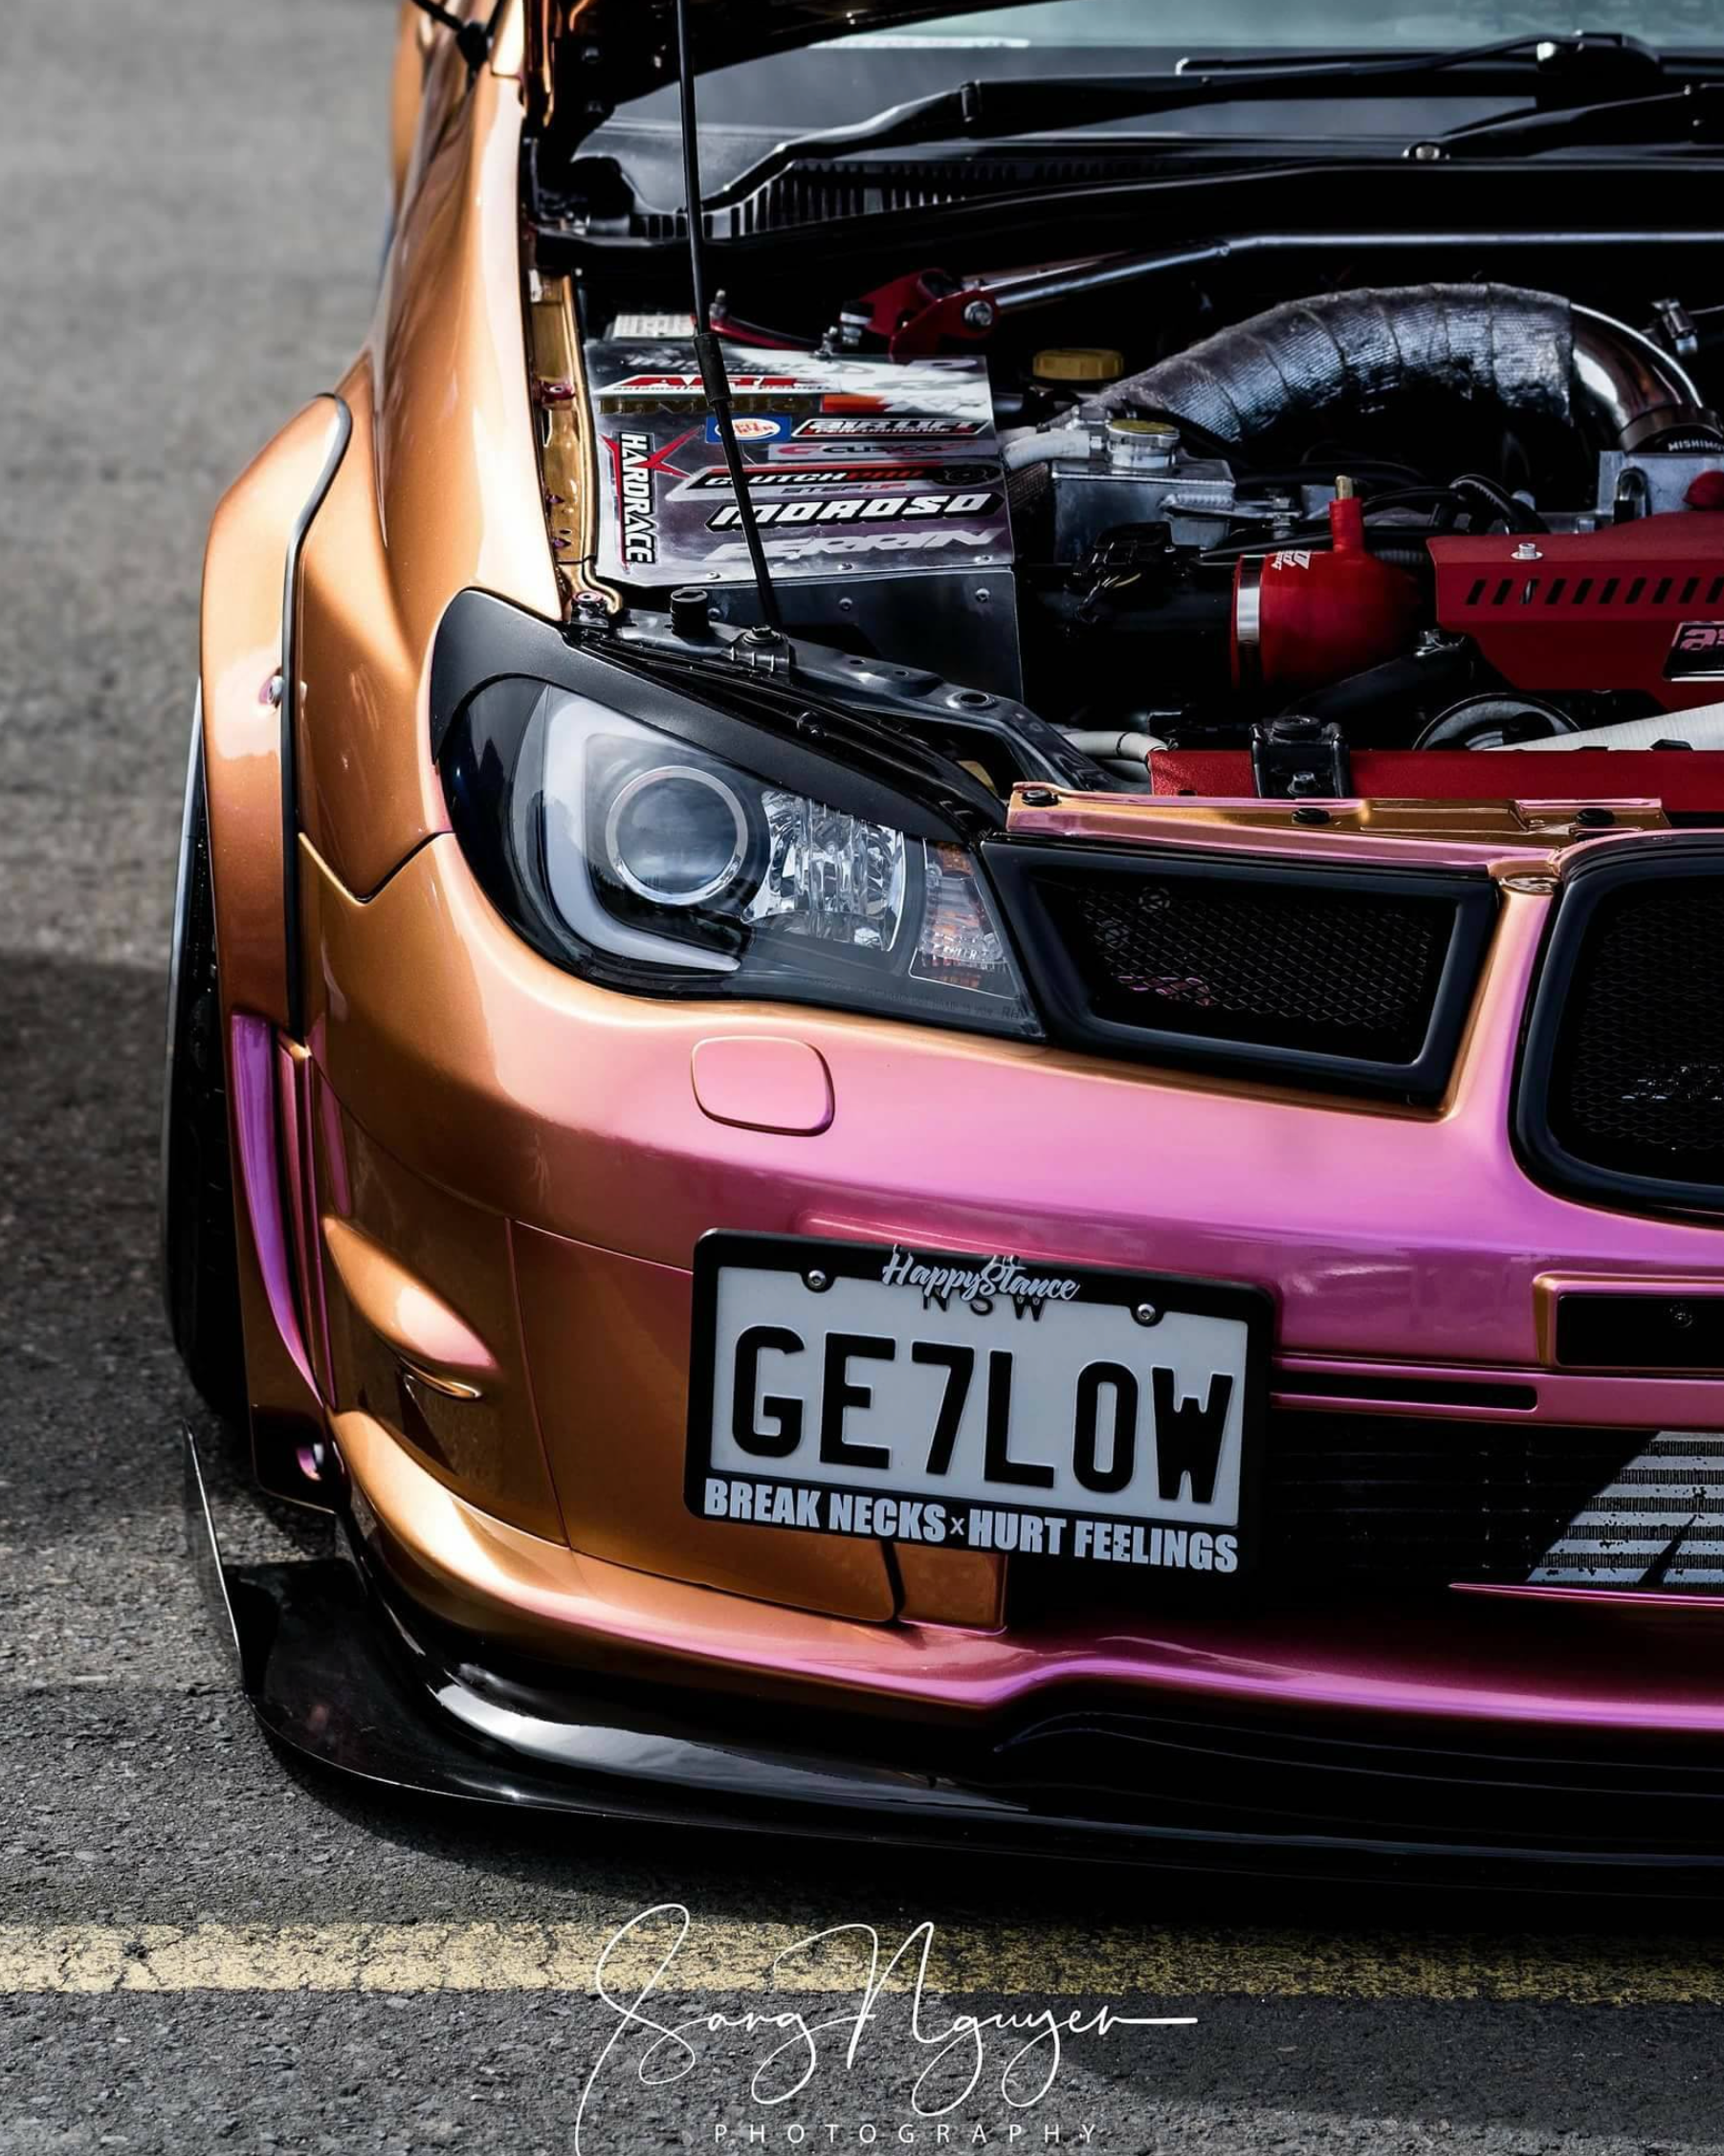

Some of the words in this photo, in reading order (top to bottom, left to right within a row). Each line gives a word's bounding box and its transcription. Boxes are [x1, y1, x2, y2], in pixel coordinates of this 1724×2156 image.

[1668, 438, 1724, 451] MISHIMO
[621, 433, 653, 563] HARDRACE
[704, 473, 848, 486] CUTCH
[711, 493, 993, 526] MOROSO
[882, 1248, 1080, 1301] HappyStance
[704, 1479, 821, 1530] BREAK
[829, 1494, 947, 1544] NECKS
[967, 1509, 1068, 1556] HURT
[1073, 1526, 1239, 1574] FEELINGS
